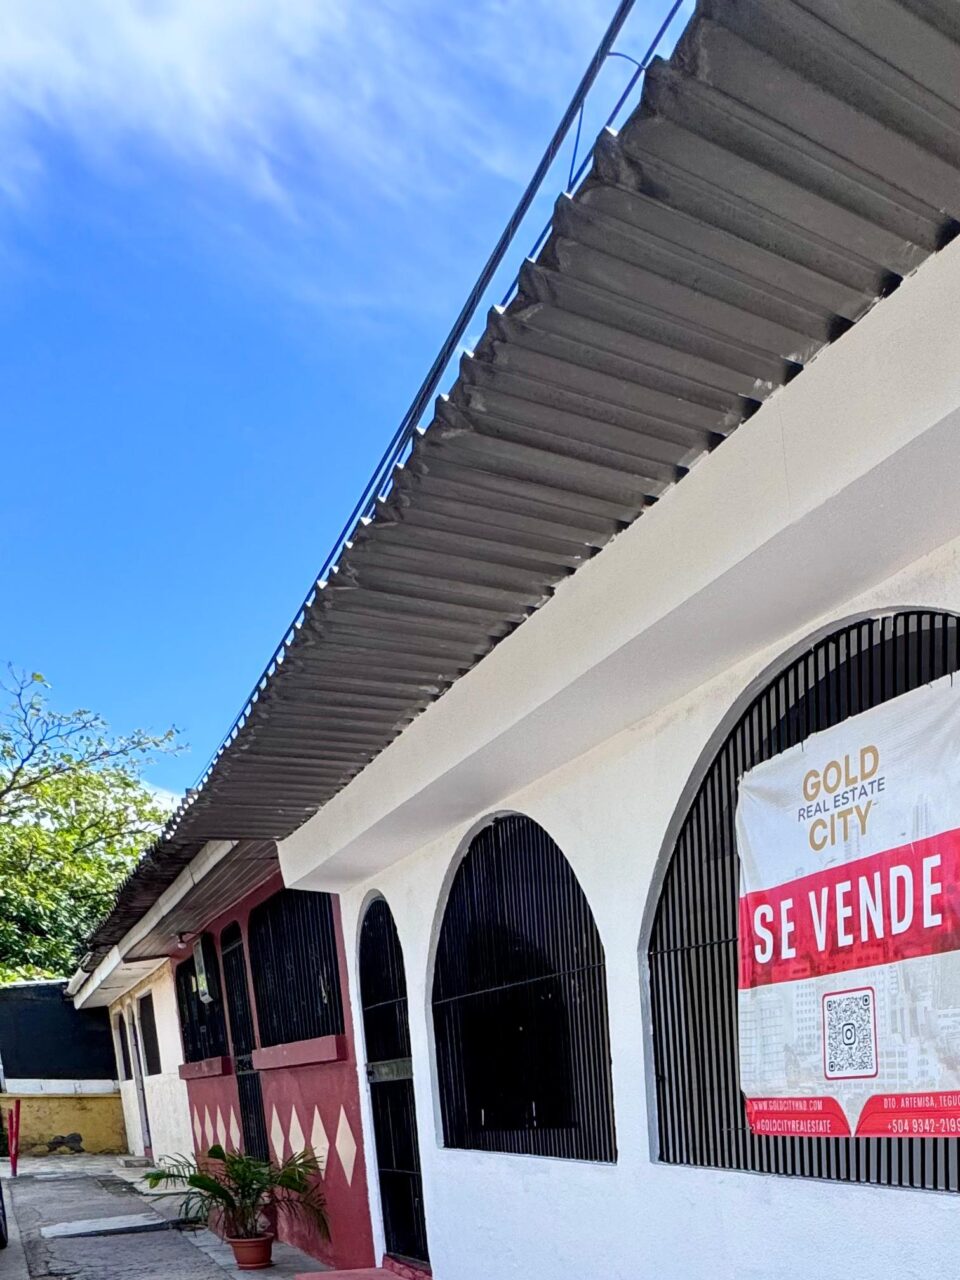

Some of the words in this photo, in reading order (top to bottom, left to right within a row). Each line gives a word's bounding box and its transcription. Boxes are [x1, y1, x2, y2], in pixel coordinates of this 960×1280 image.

[798, 800, 830, 822] REAL
[833, 776, 886, 809] ESTATE
[803, 745, 880, 802] GOLD
[809, 800, 873, 851] CITY
[754, 898, 796, 964] SE
[808, 854, 942, 952] VENDE
[887, 1119, 909, 1133] +504
